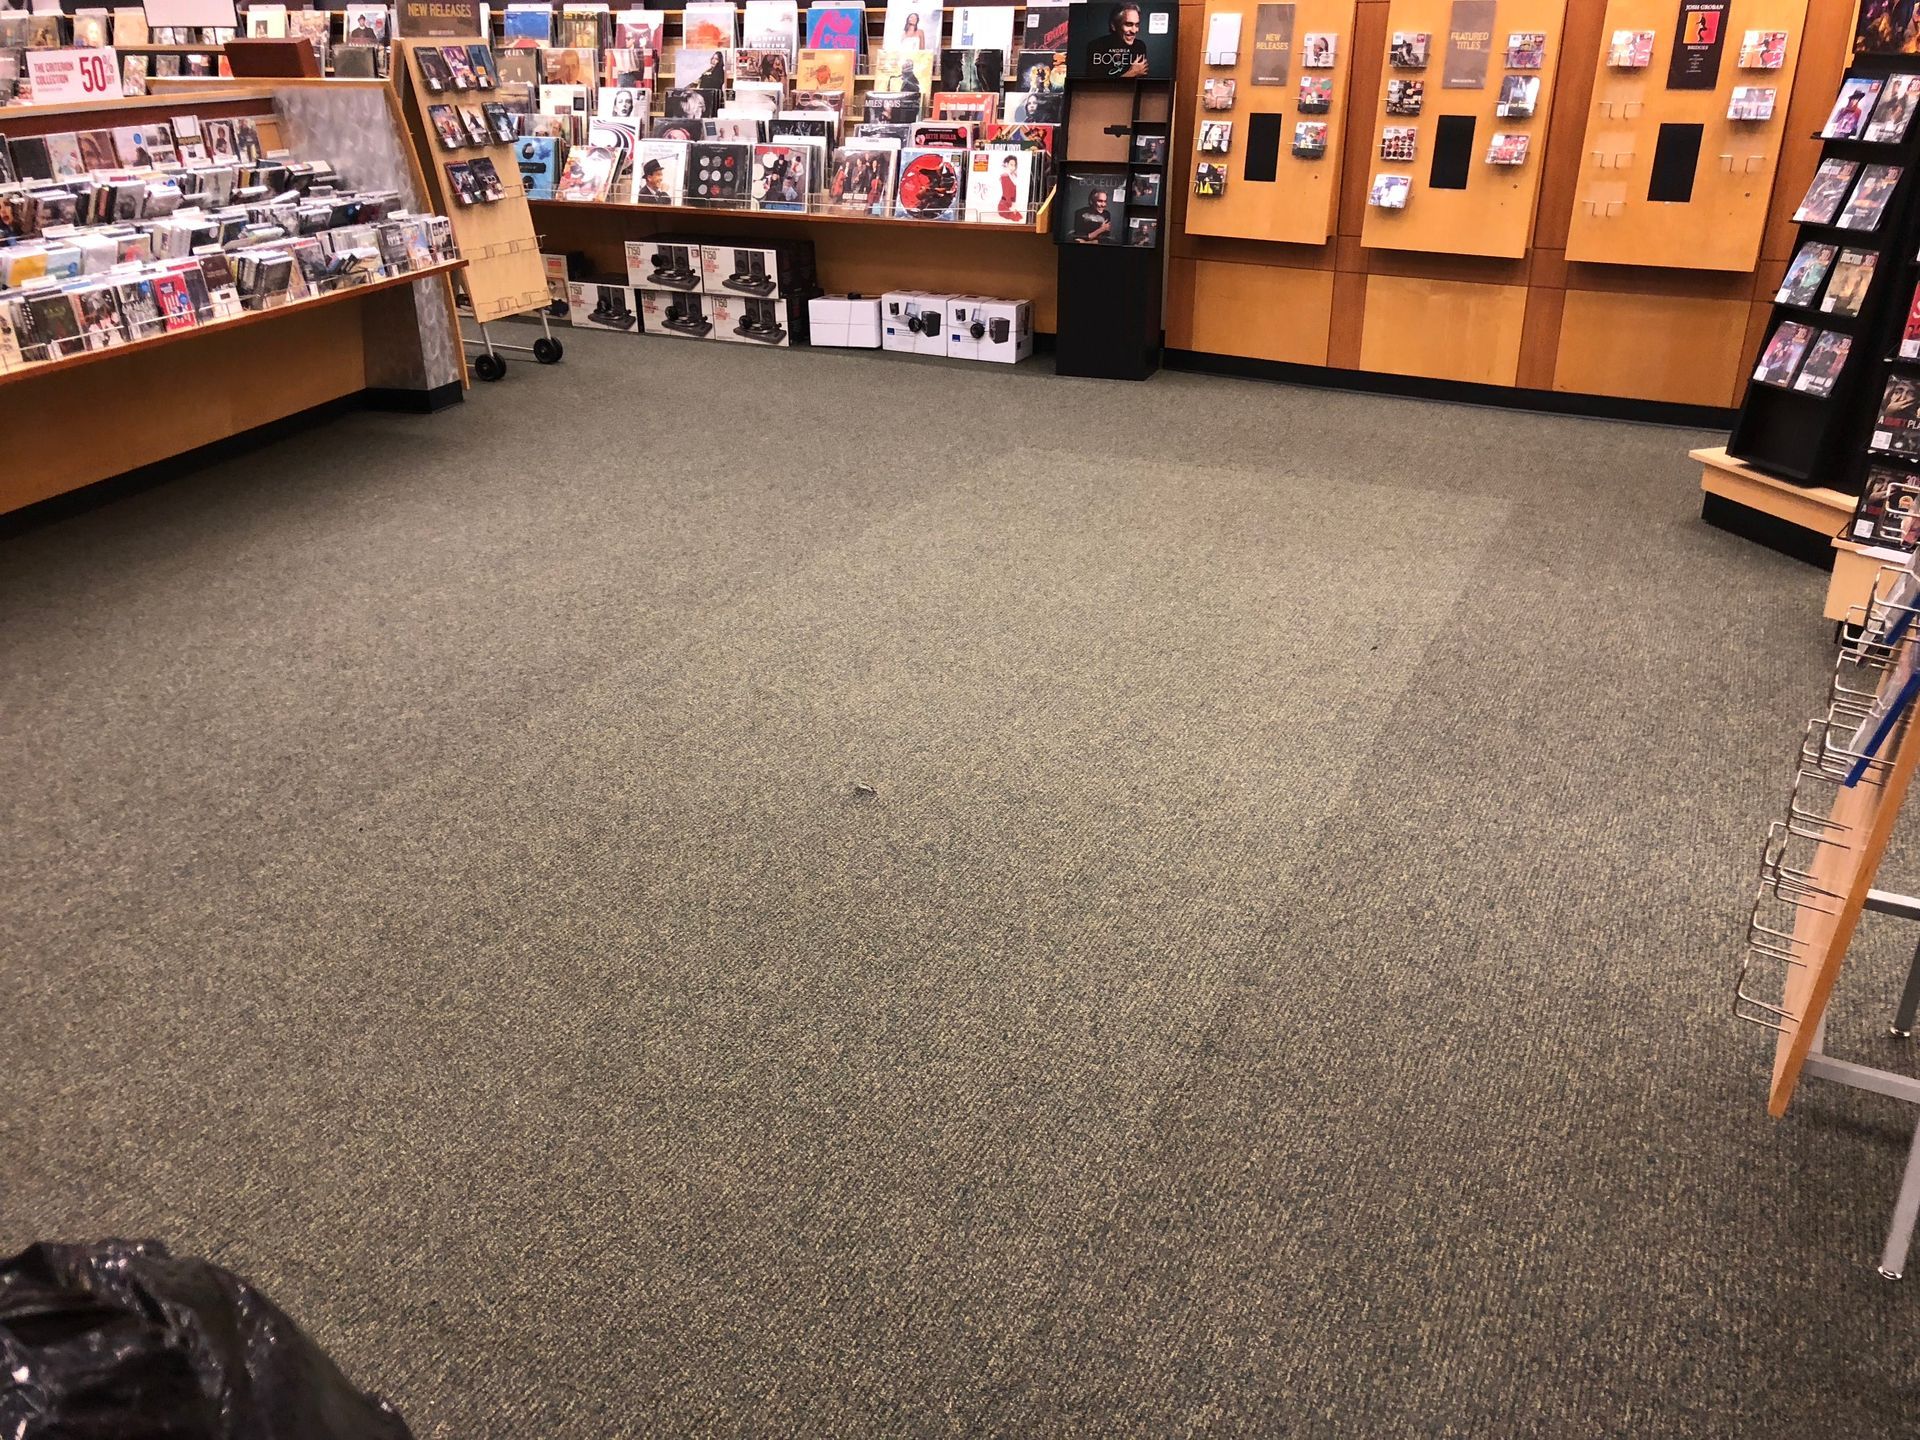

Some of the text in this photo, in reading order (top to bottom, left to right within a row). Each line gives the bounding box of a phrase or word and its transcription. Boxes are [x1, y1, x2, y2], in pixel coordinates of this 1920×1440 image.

[408, 3, 472, 18] NEW RELEASES
[1265, 33, 1282, 41] NEW
[1450, 31, 1490, 41] FEATURED
[1255, 42, 1290, 50] RELEASES
[1456, 41, 1482, 50] TITLES
[627, 246, 641, 256] T150
[702, 250, 717, 260] T150
